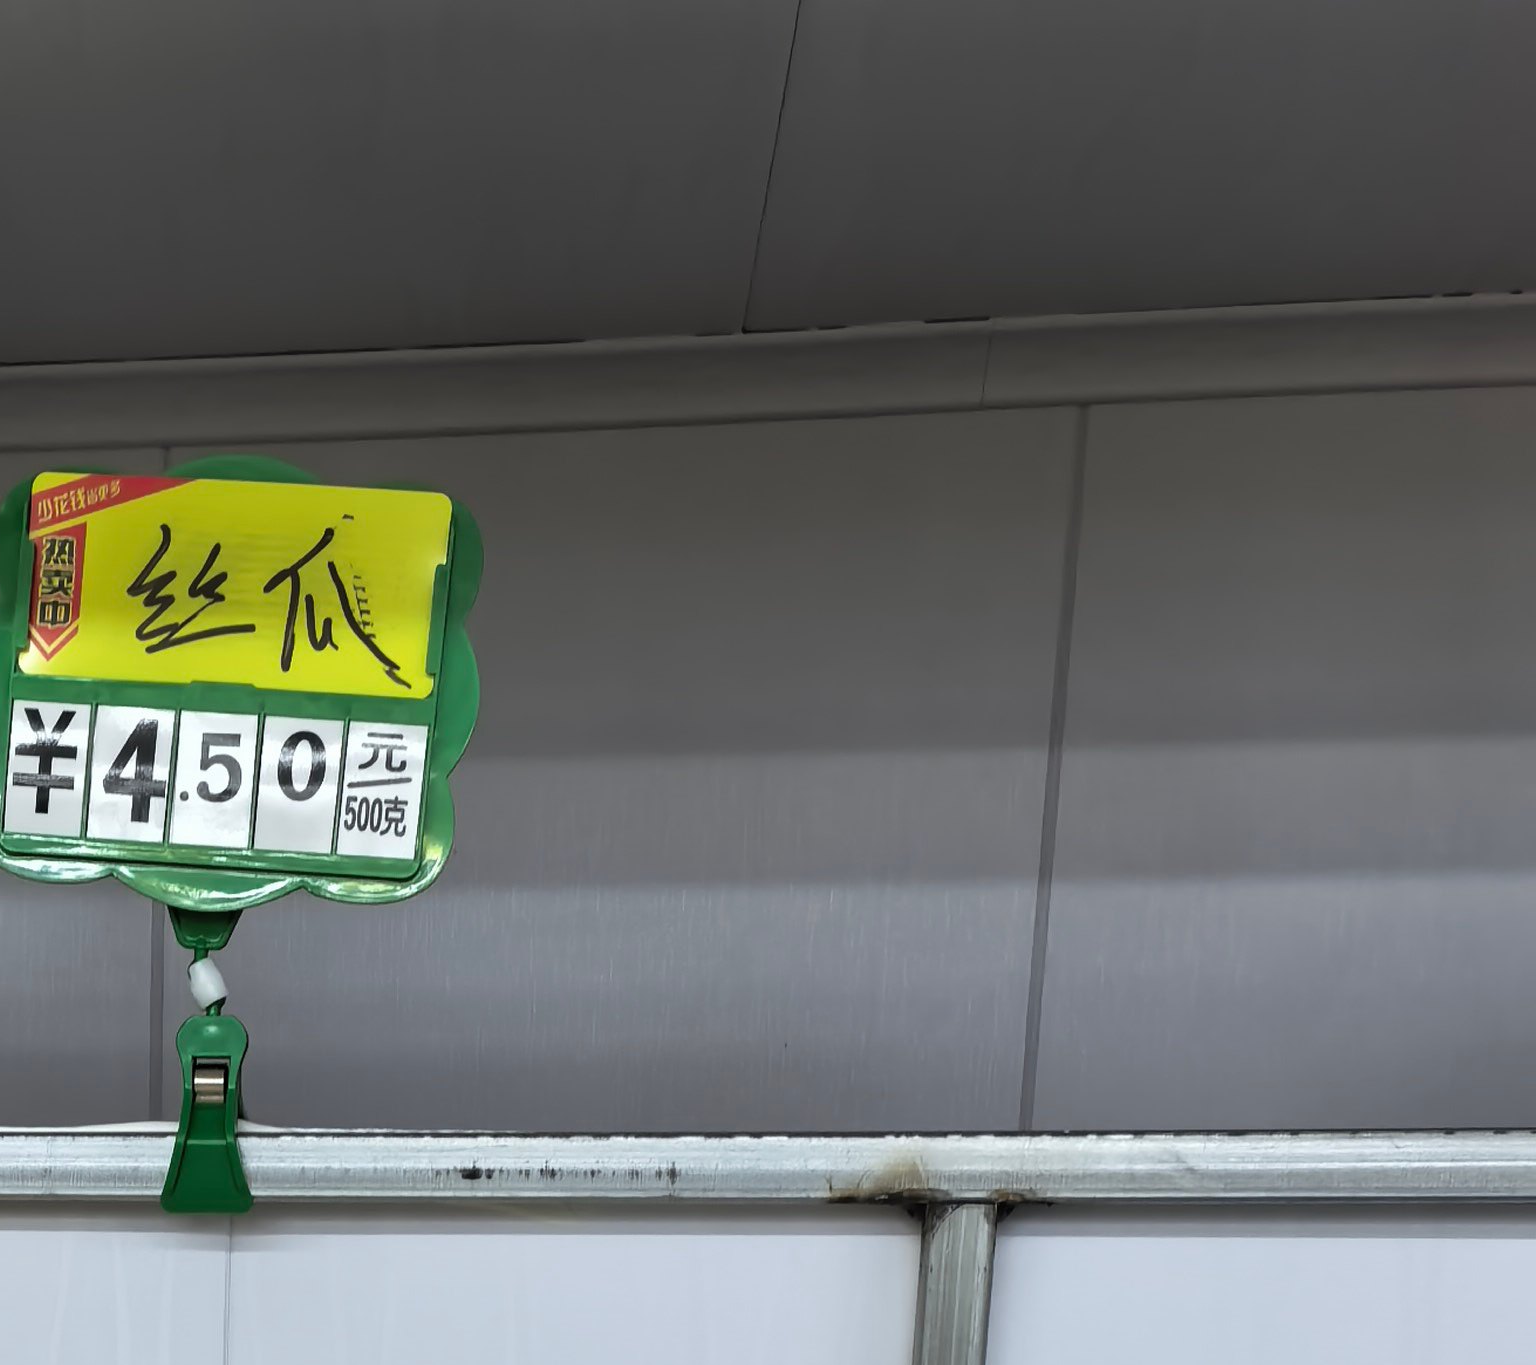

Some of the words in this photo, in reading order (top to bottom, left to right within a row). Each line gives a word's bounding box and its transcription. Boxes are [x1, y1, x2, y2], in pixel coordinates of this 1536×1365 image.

[38, 537, 76, 628] 热卖中
[125, 513, 412, 690] 丝瓜
[357, 731, 408, 774] 元
[343, 795, 408, 838] 500克
